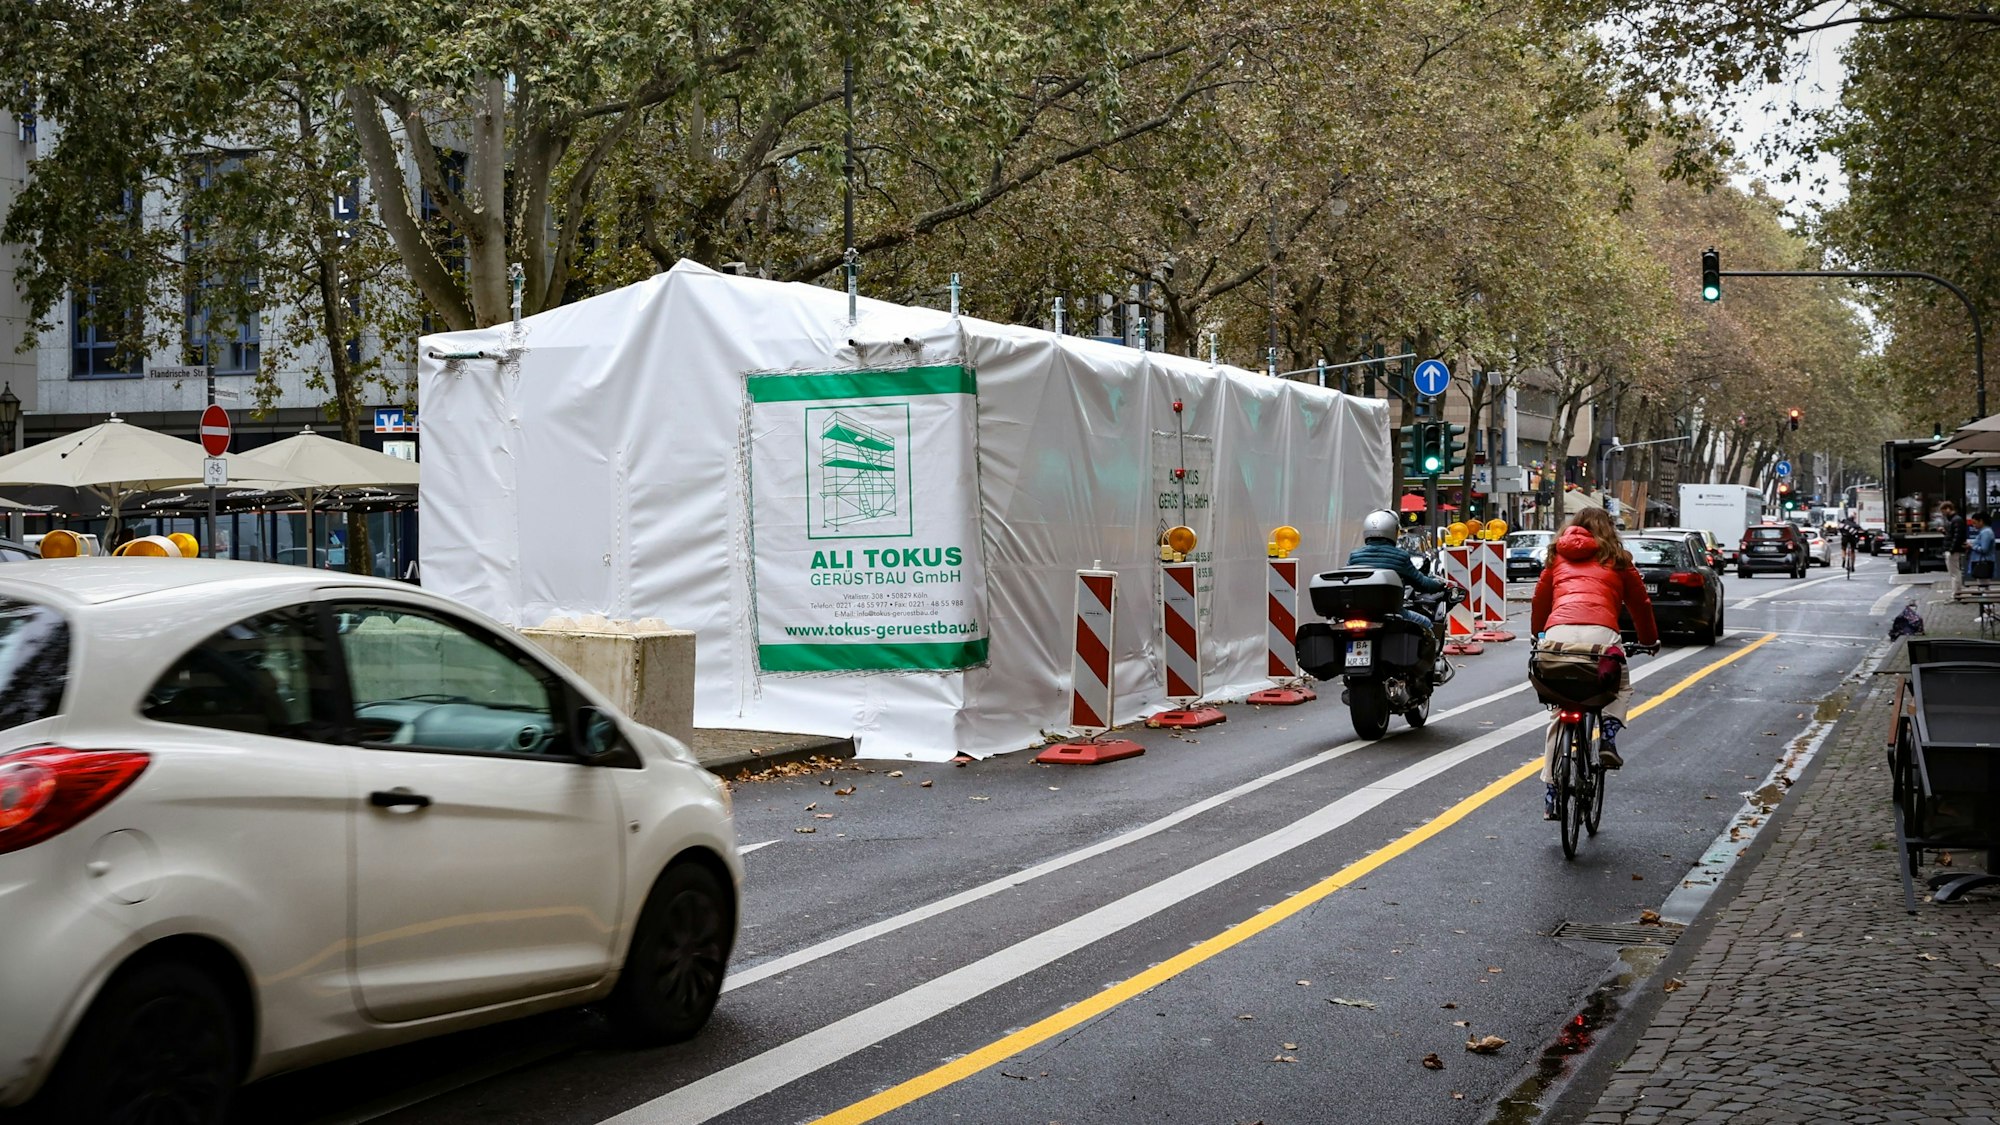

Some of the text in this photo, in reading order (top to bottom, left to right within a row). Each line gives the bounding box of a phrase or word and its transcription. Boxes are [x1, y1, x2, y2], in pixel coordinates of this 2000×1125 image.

[150, 368, 206, 378] Flandrische Str.
[810, 546, 963, 569] ALI TOKUS
[810, 570, 961, 586] GERÜSTBAU GmbH
[908, 600, 925, 608] 0221
[951, 599, 964, 607] 988
[856, 608, 939, 618] info@tokus-geruestbau.de
[1356, 641, 1368, 649] BA
